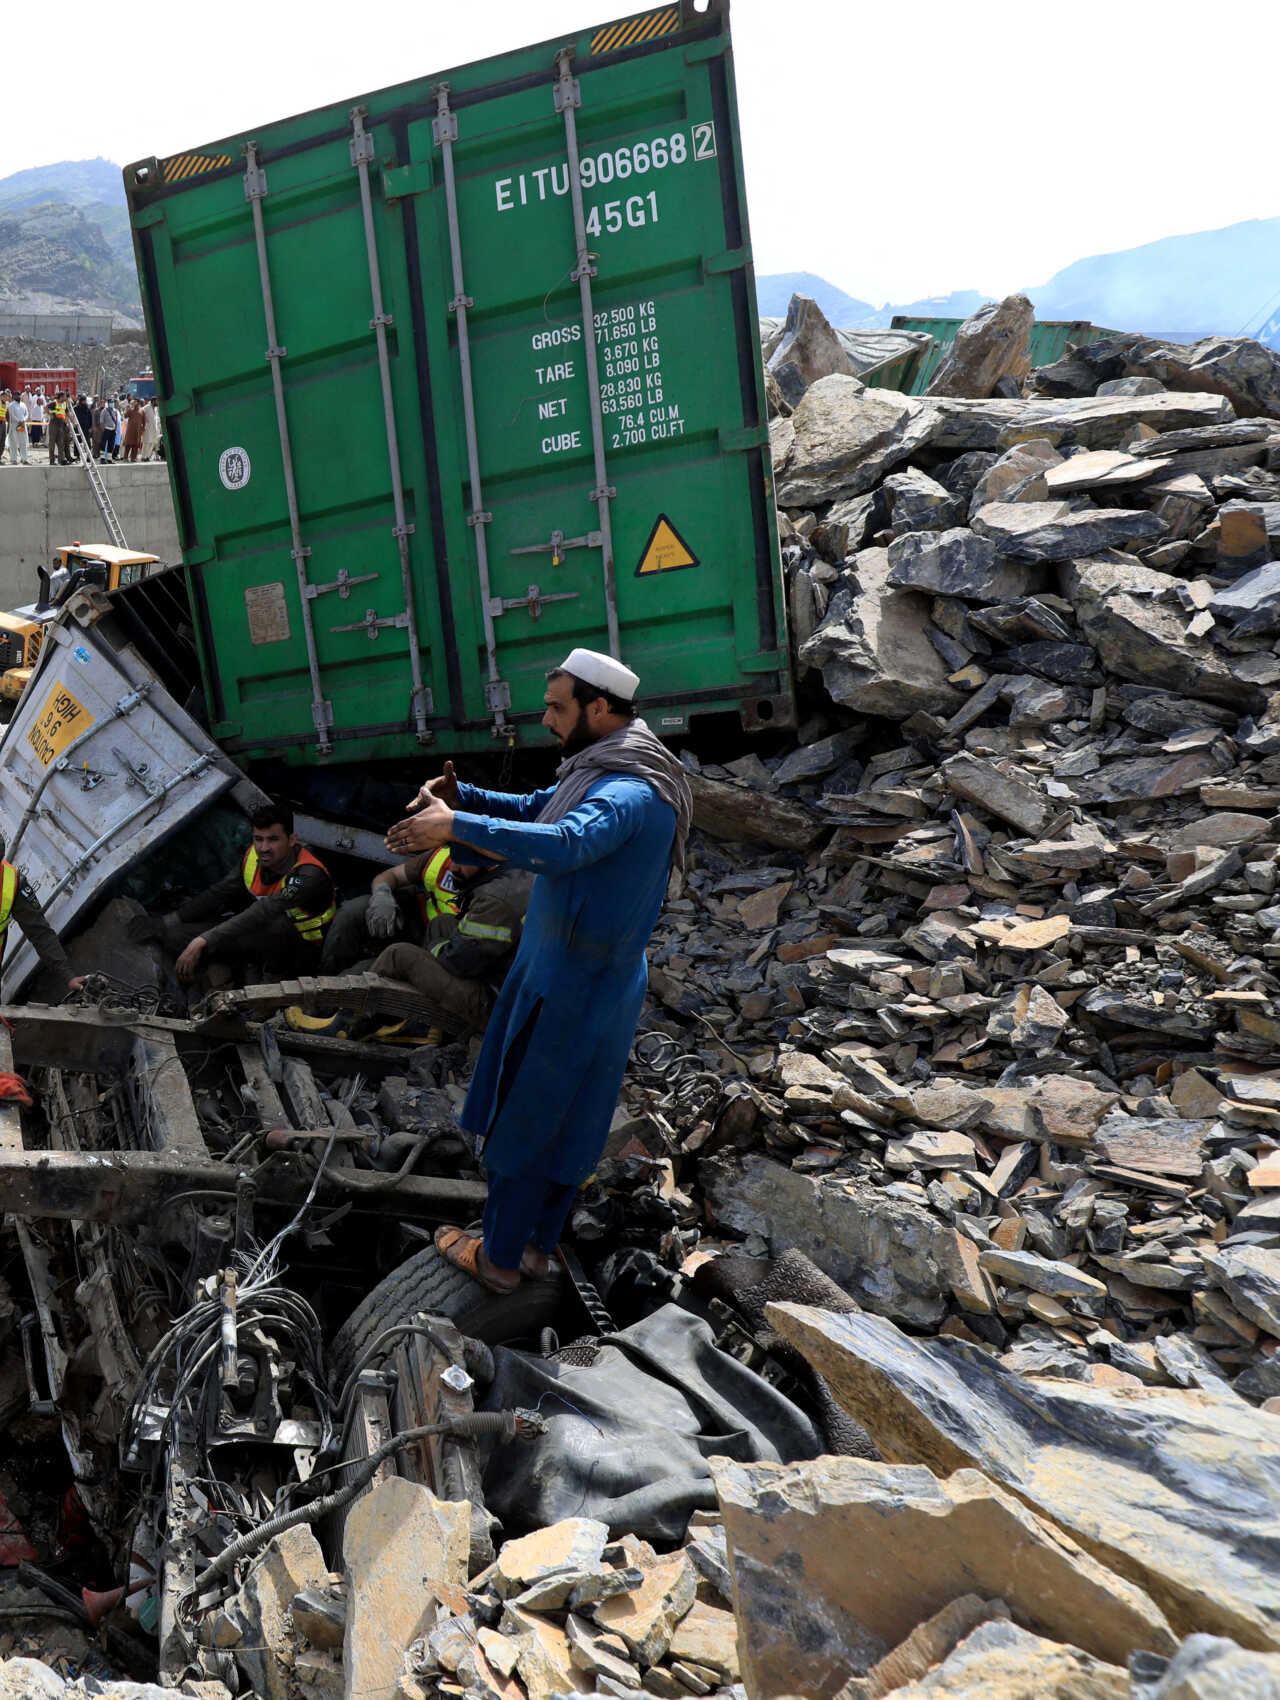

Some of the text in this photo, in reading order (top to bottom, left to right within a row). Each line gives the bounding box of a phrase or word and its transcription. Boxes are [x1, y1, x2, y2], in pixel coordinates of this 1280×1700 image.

[495, 124, 715, 212] EITU 906668 2
[586, 190, 659, 237] 45G1
[593, 301, 656, 328] 32.500 KG
[532, 325, 581, 350] GROSS
[595, 317, 657, 344] 71.650 LB
[603, 336, 659, 361] 3.670 KG
[535, 361, 575, 384] TARE
[606, 352, 660, 377] 8.090 LB
[600, 372, 662, 399] 28.830 KG
[538, 399, 567, 420] NET
[602, 388, 664, 414] 63.560 LB
[618, 404, 679, 430] 76.4 CU.M
[542, 431, 582, 454] CUBE
[612, 420, 685, 448] 2.700 CU.FT
[54, 691, 81, 723] HIGH
[31, 723, 55, 765] CAUTION
